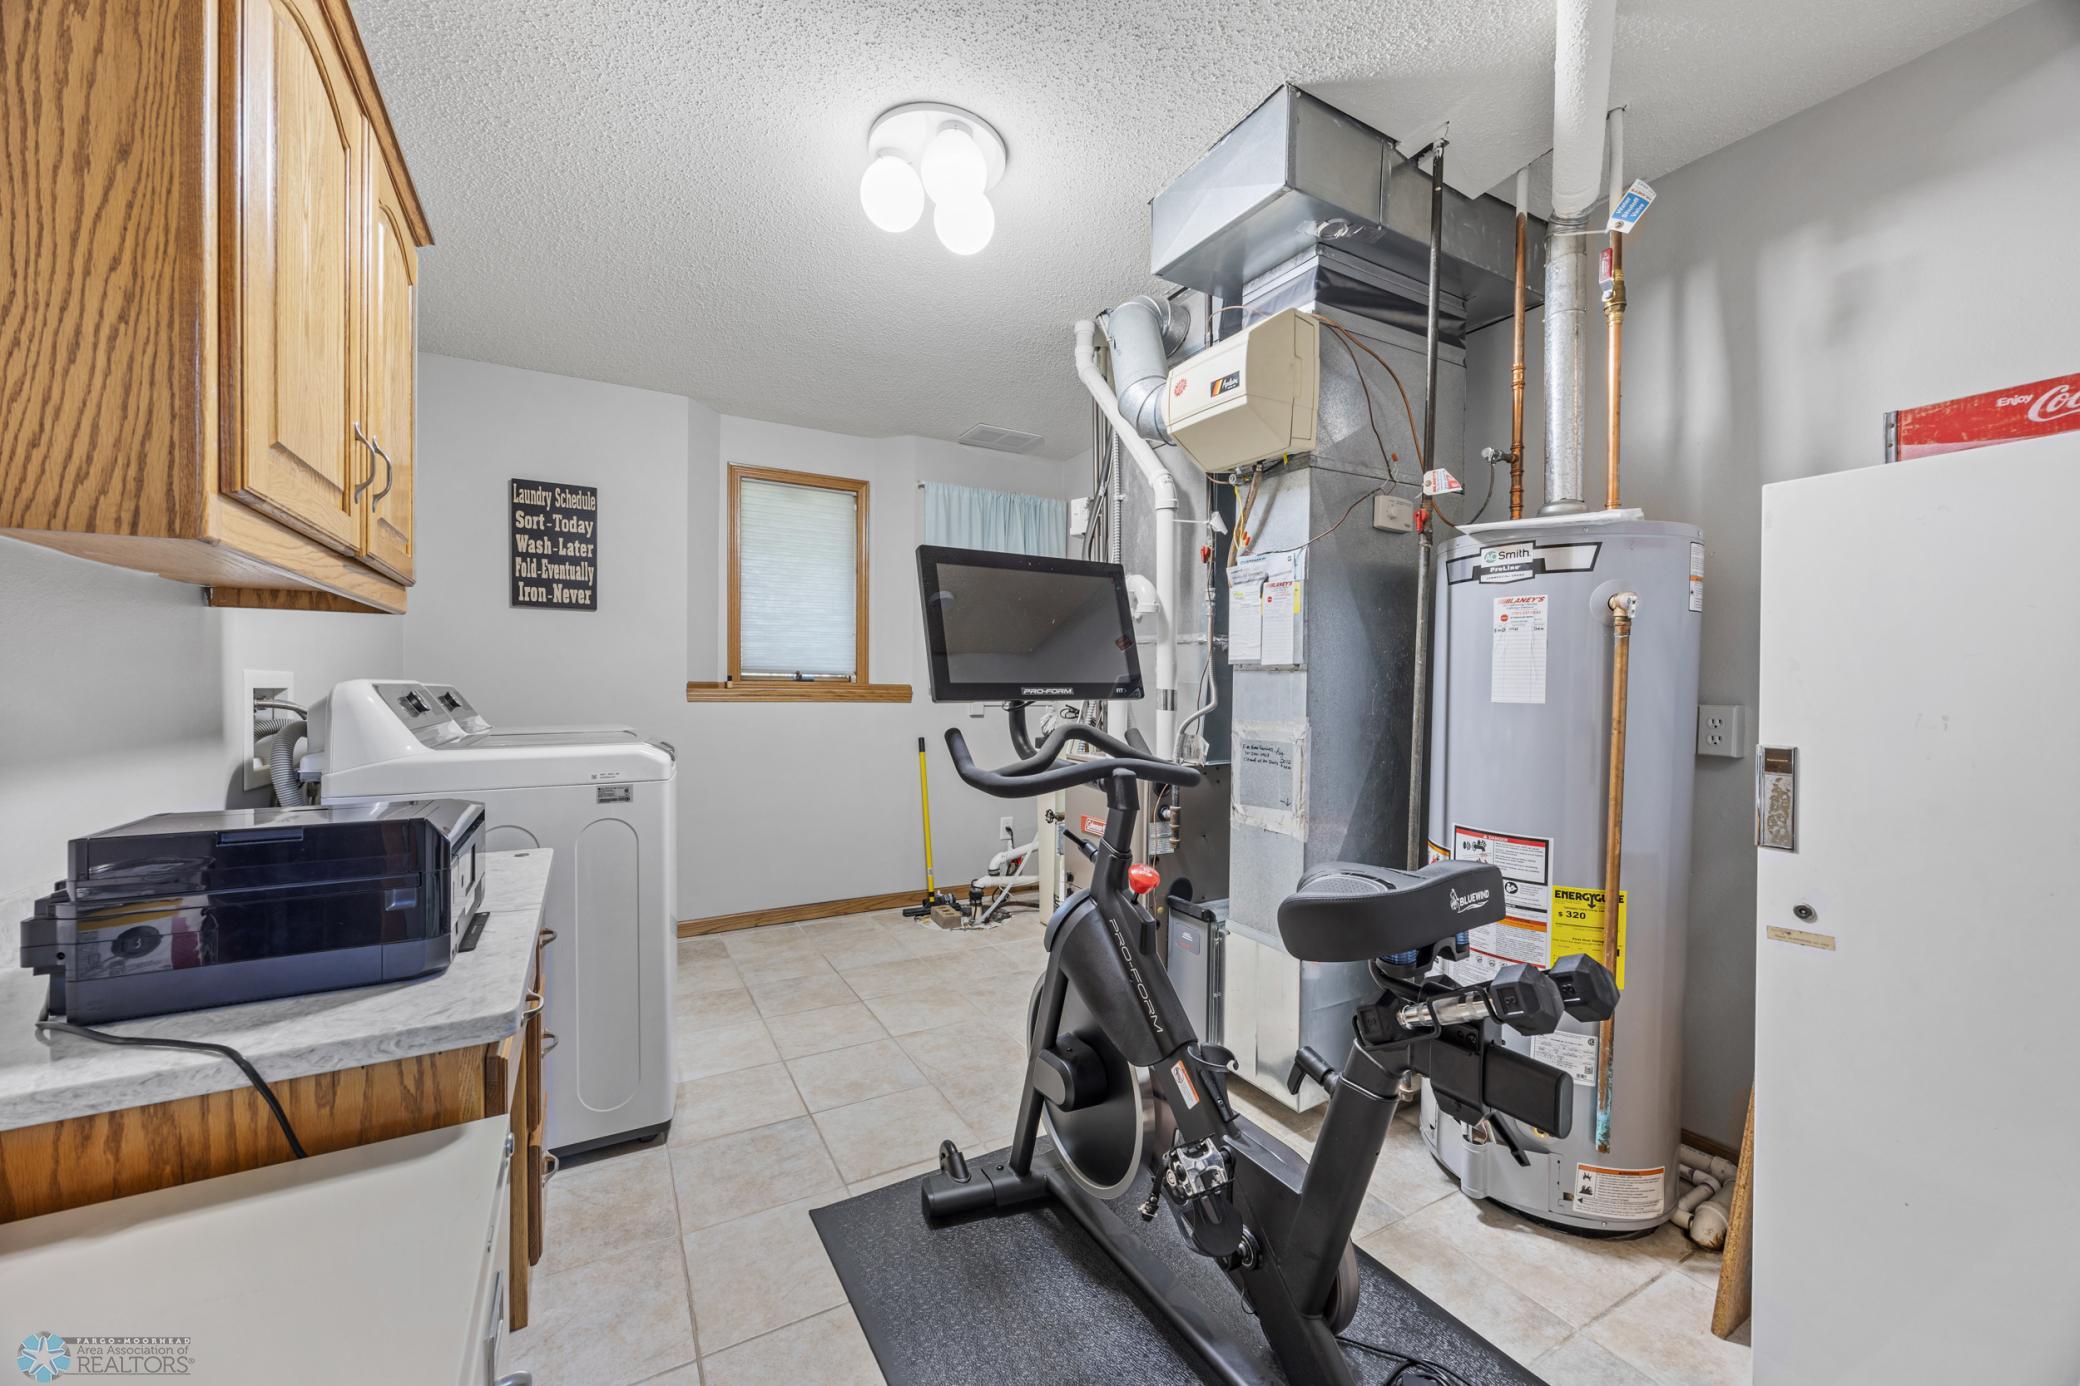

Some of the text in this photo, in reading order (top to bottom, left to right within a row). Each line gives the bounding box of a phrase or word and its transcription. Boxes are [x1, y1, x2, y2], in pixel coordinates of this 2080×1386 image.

[1996, 393, 2033, 407] Enjoy
[513, 483, 596, 511] Laundry Schedule
[1498, 548, 1530, 560] Smith
[1460, 889, 1490, 907] BLUEWIND
[1566, 911, 1586, 919] 320
[1109, 918, 1164, 1033] PRO-FORM
